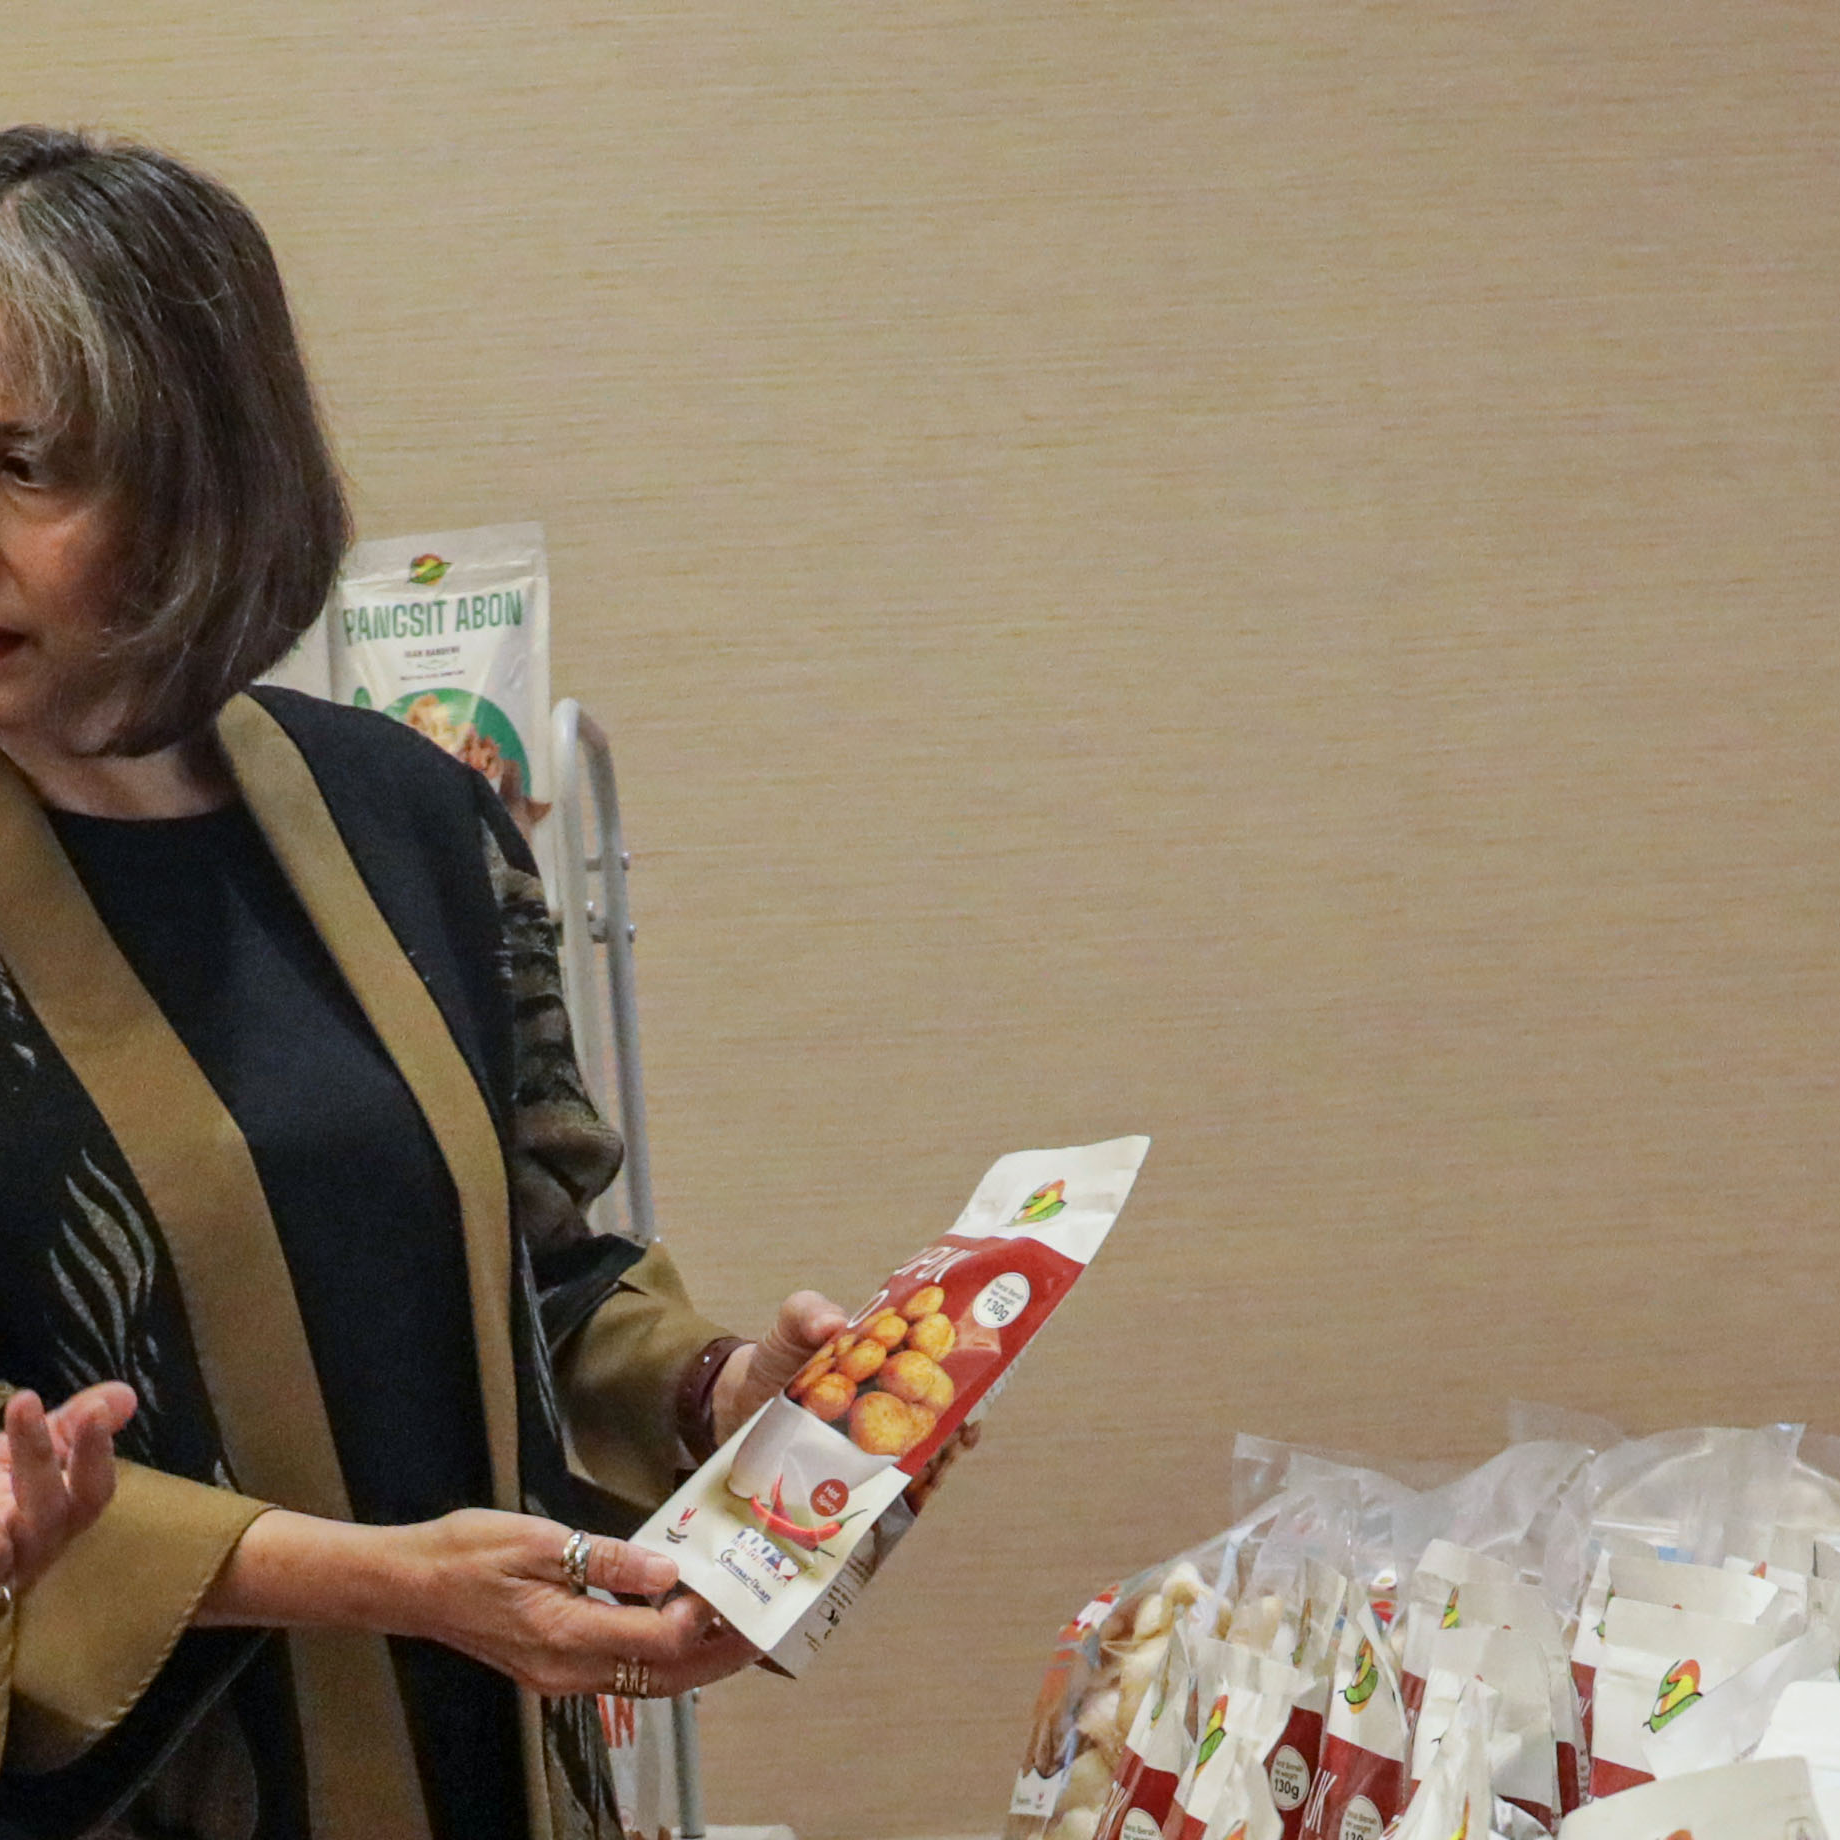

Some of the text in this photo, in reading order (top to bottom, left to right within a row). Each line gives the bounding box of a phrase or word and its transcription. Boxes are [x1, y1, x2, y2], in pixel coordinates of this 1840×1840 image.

[344, 590, 524, 646] PANGSIT ABON
[983, 1297, 1010, 1322] 130g
[1274, 1777, 1300, 1800] 130g
